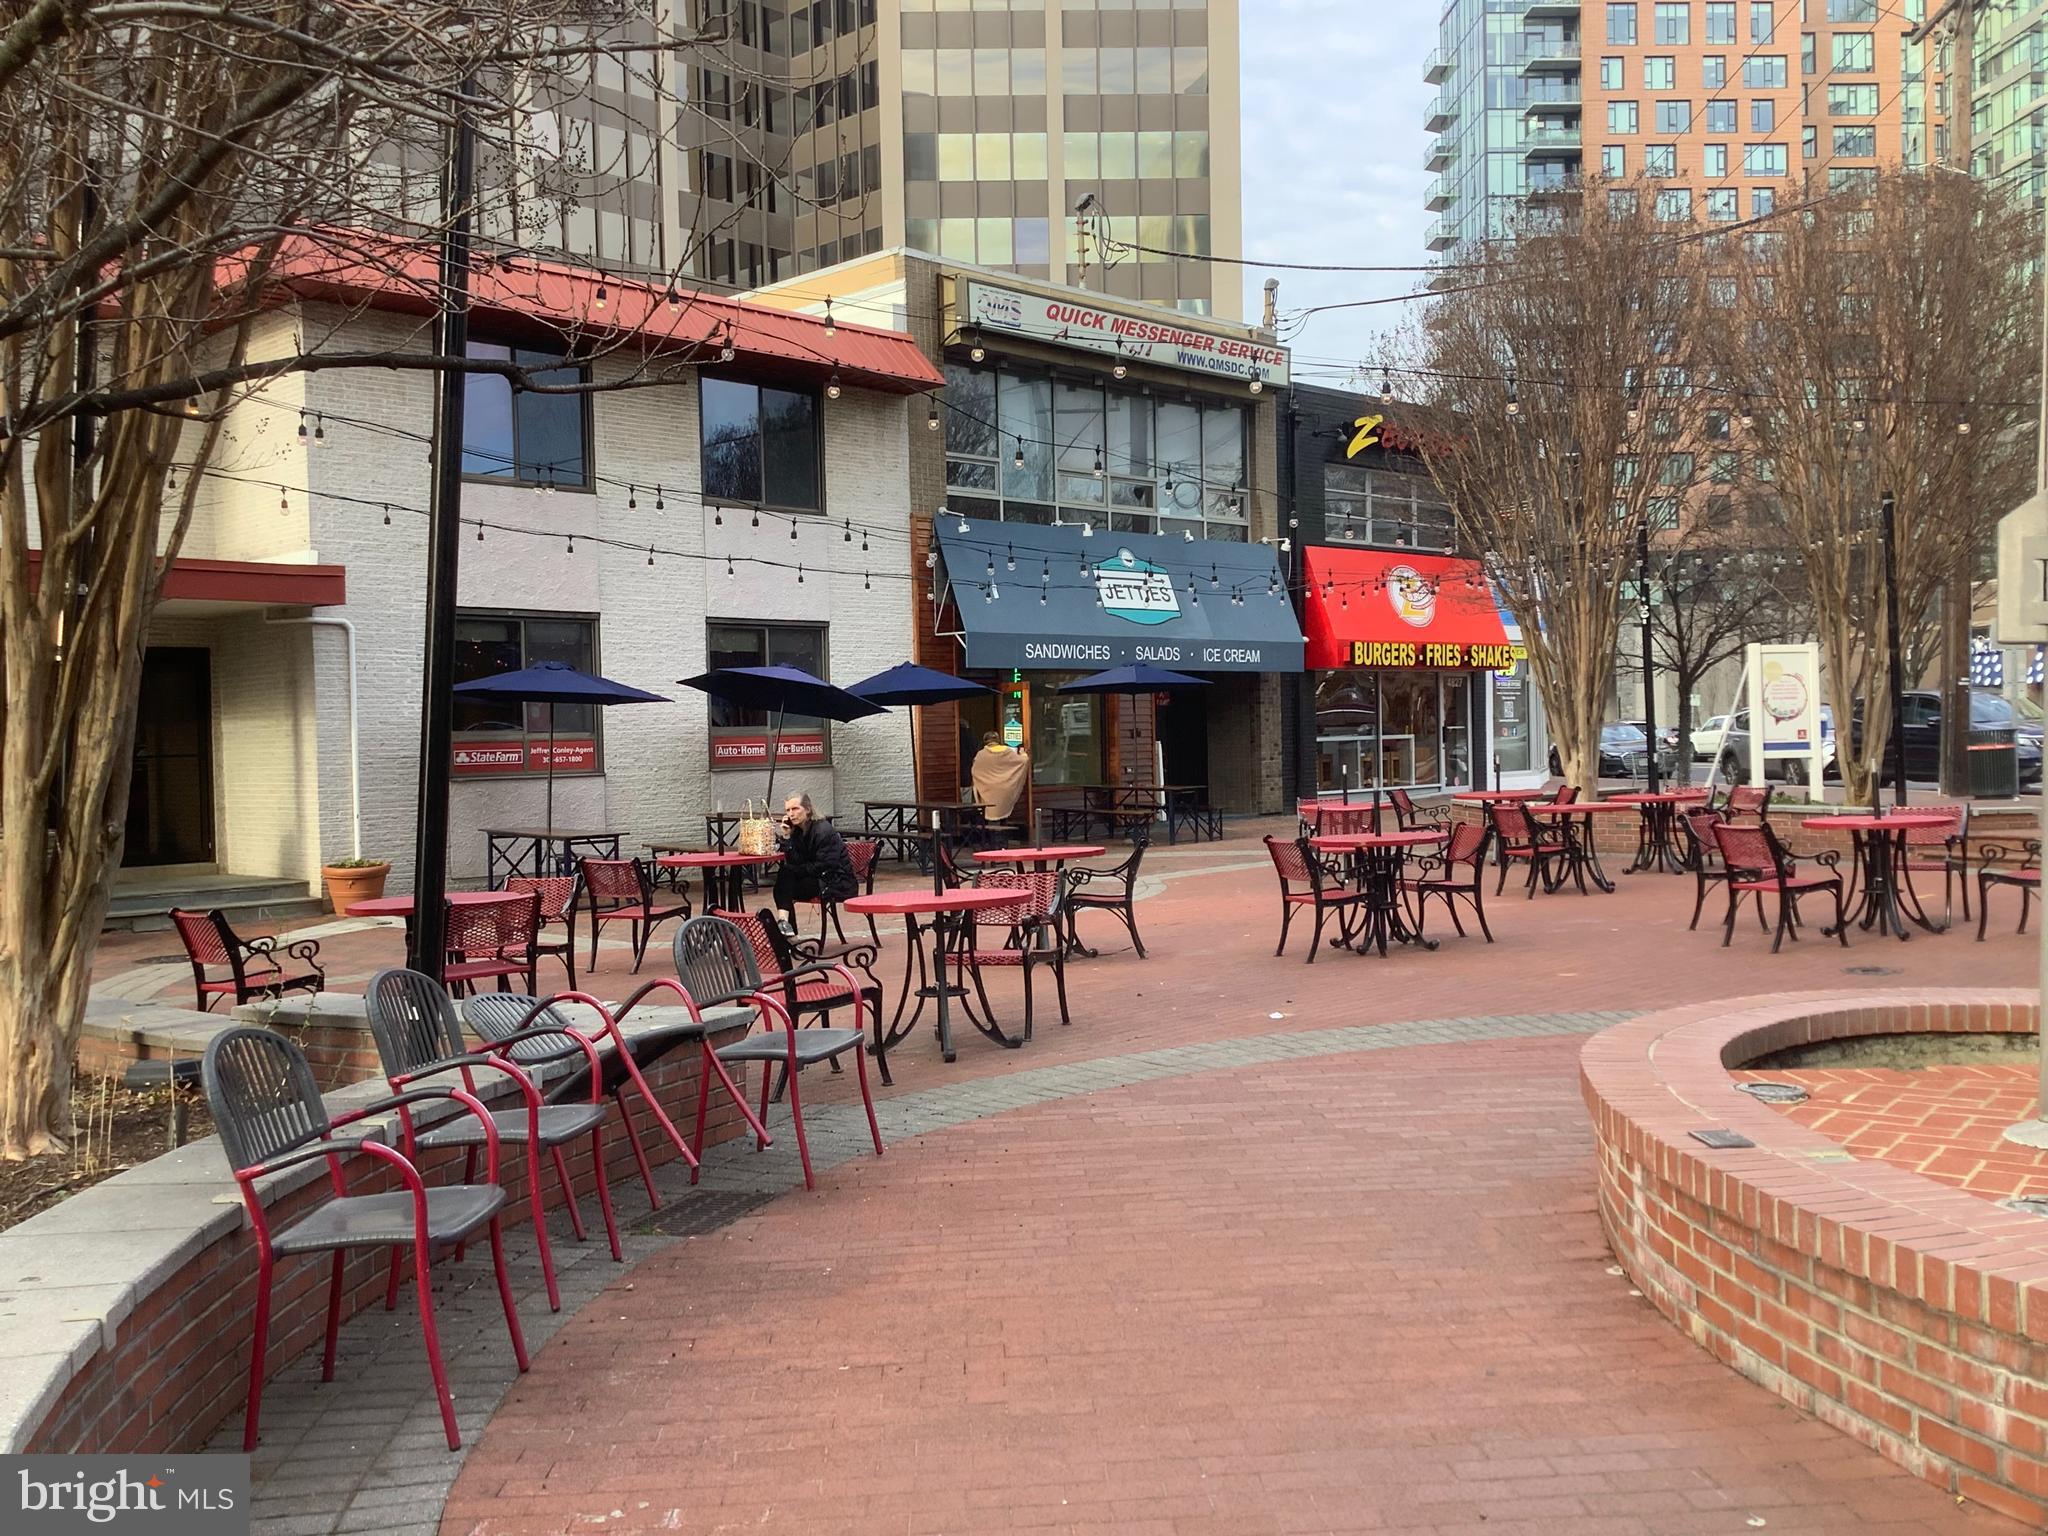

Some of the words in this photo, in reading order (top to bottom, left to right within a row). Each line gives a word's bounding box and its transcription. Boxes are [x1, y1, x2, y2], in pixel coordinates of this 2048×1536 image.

[1045, 303, 1105, 331] QUICK
[1110, 317, 1215, 352] MESSENGER
[1218, 340, 1284, 366] SERVICE
[1177, 351, 1270, 380] WWW.QMSDC.COM
[1025, 643, 1111, 661] SANDWICHES
[1135, 646, 1181, 662] SALADS
[1203, 647, 1221, 663] ICE
[1223, 648, 1261, 664] CREAM
[1354, 641, 1416, 667] BURGERS
[1426, 643, 1461, 667] FRIES
[1471, 644, 1517, 667] SHAKES
